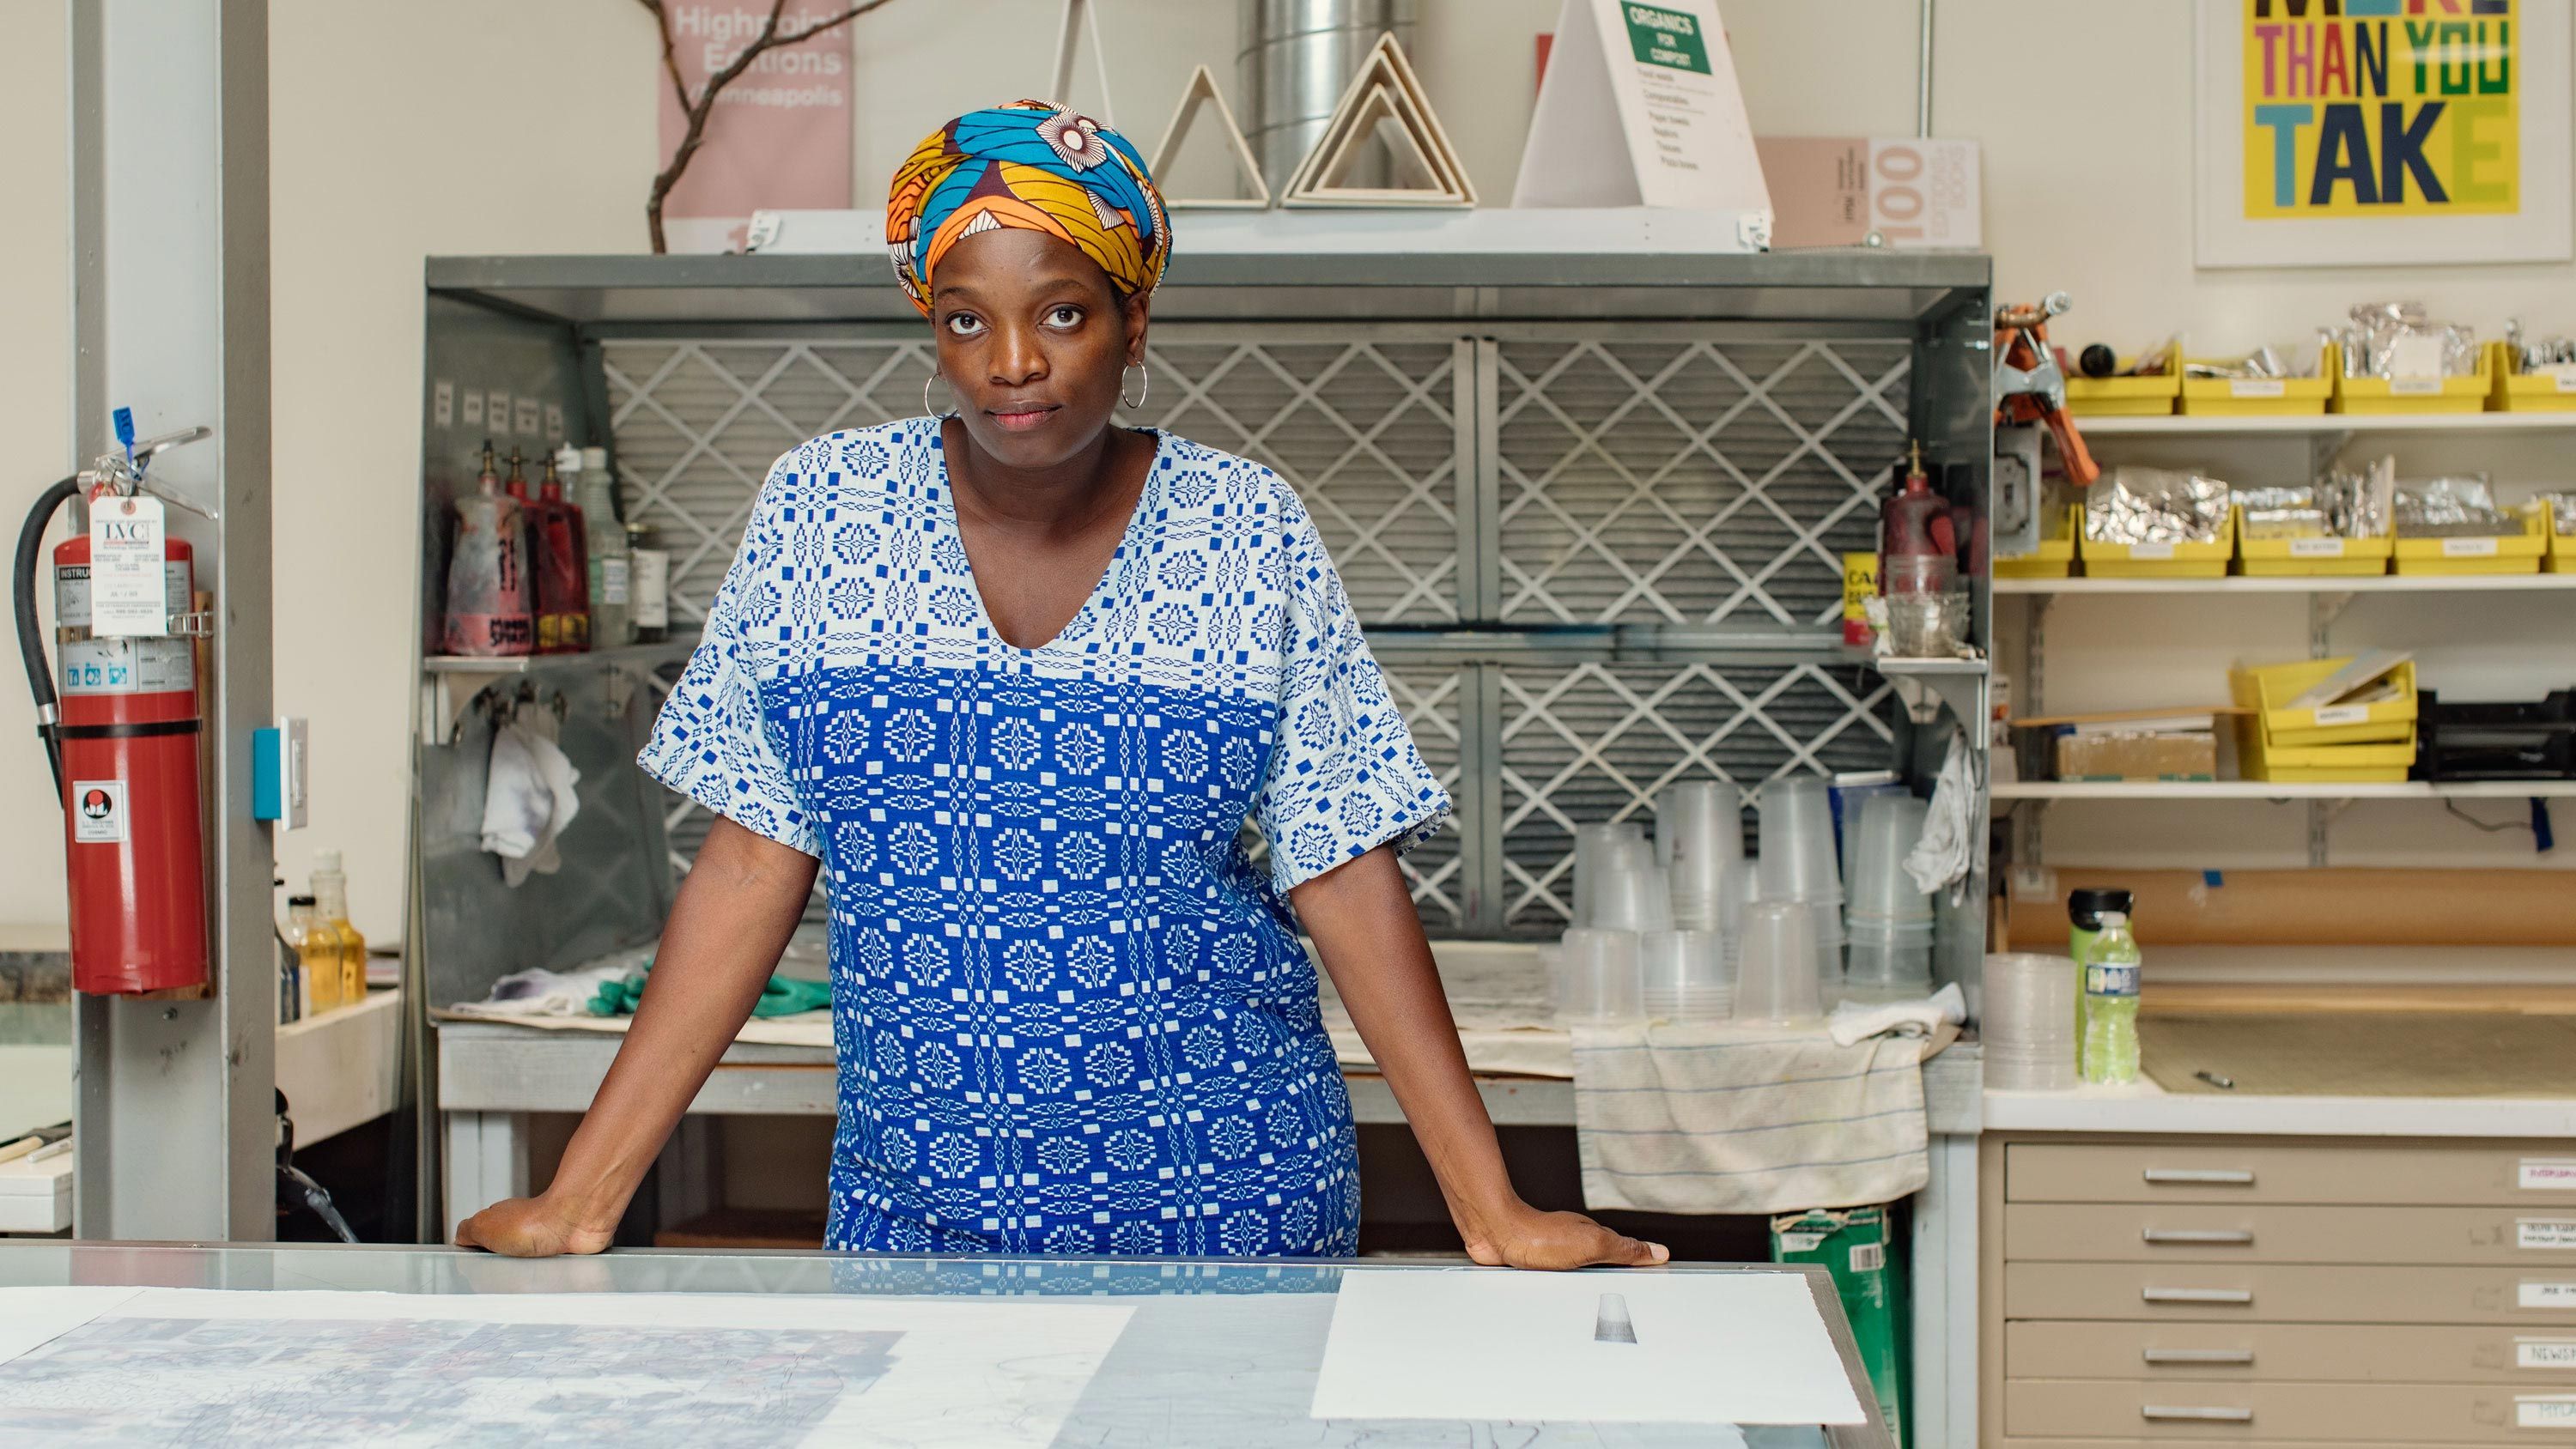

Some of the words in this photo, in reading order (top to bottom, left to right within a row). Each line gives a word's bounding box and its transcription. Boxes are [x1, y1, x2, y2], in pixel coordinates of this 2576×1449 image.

[1628, 6, 1694, 35] ORGANICS
[703, 43, 842, 75] Etions
[2255, 21, 2388, 97] THAN
[2404, 21, 2509, 94] YOU
[690, 85, 843, 106] Mnneapolis
[2255, 100, 2510, 207] TAKE
[1875, 145, 1924, 243] 100
